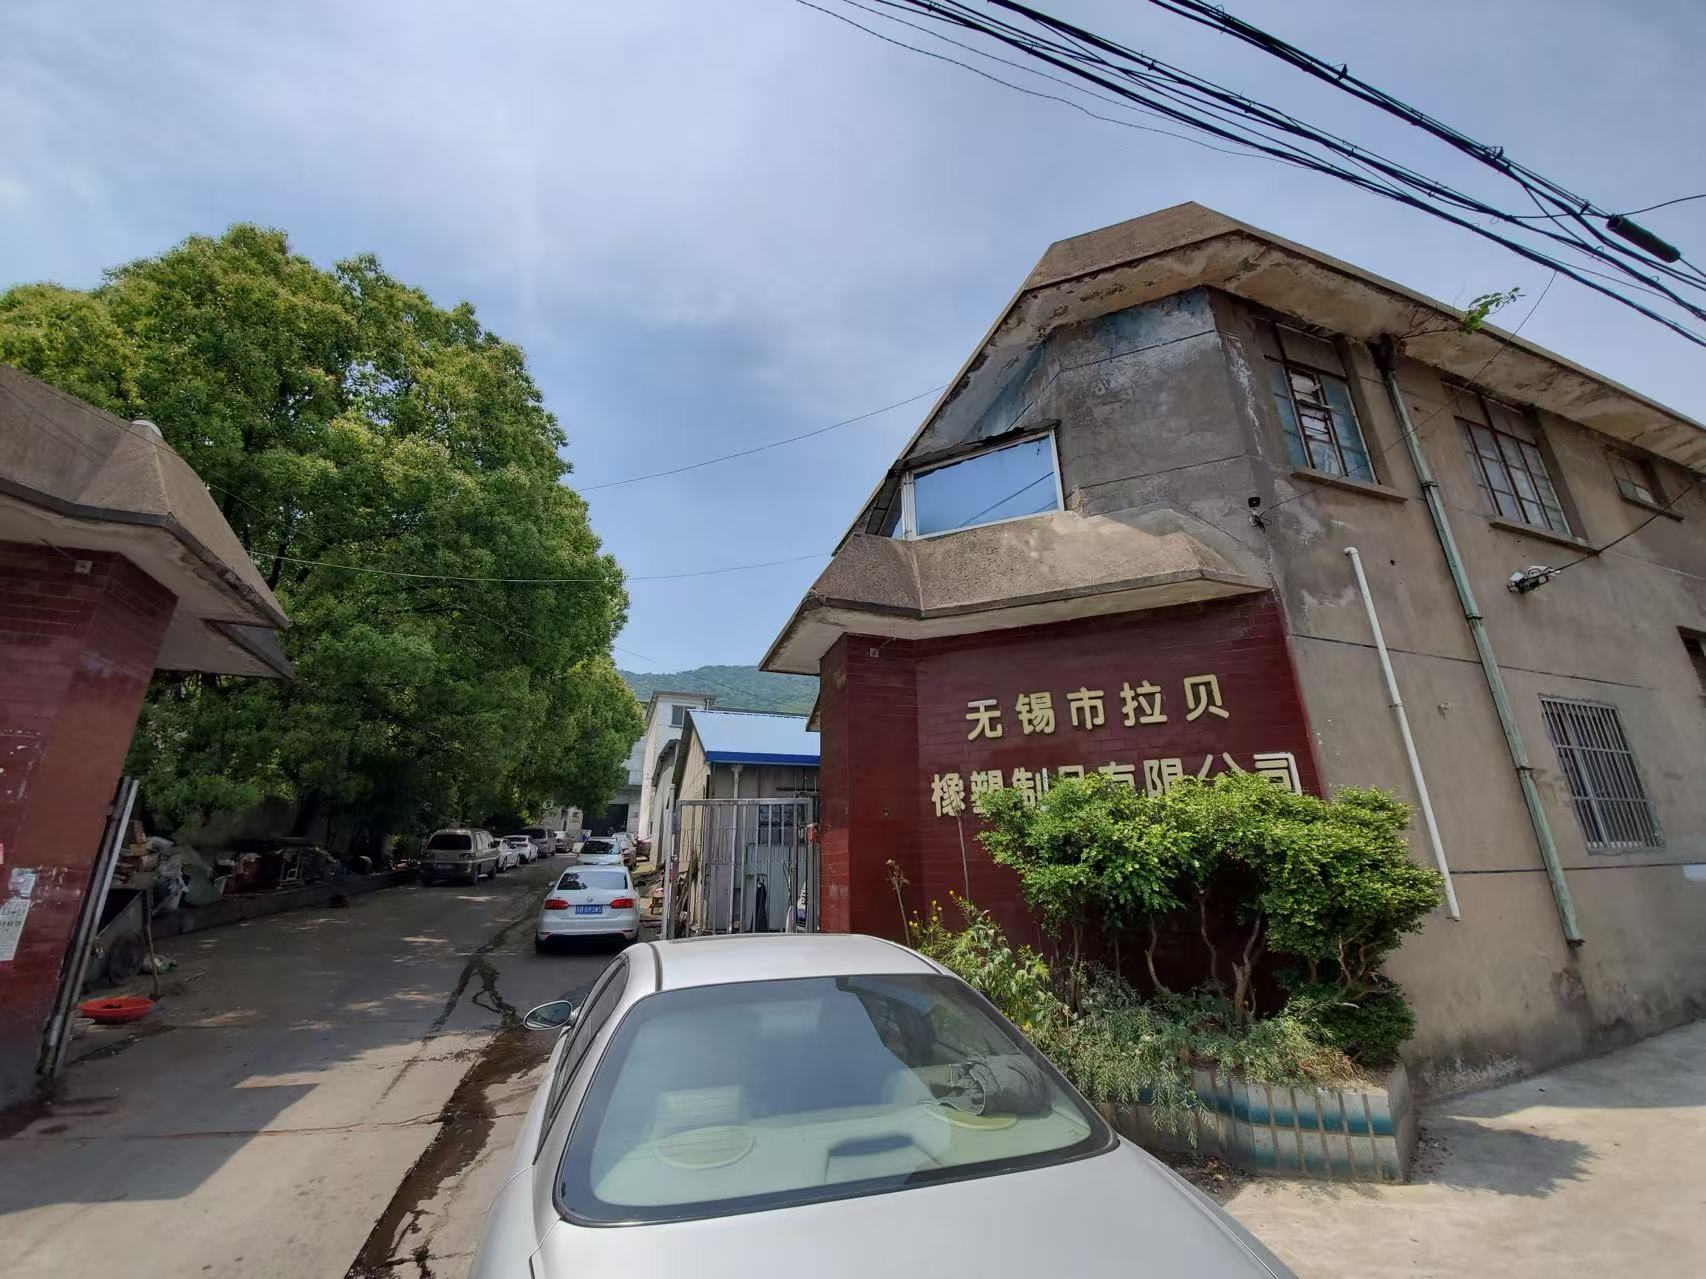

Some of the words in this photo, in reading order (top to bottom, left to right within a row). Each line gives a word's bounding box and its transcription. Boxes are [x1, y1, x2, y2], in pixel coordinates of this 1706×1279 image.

[965, 674, 1230, 741] 无锡市拉贝
[931, 752, 1303, 817] 橡塑制有限公司
